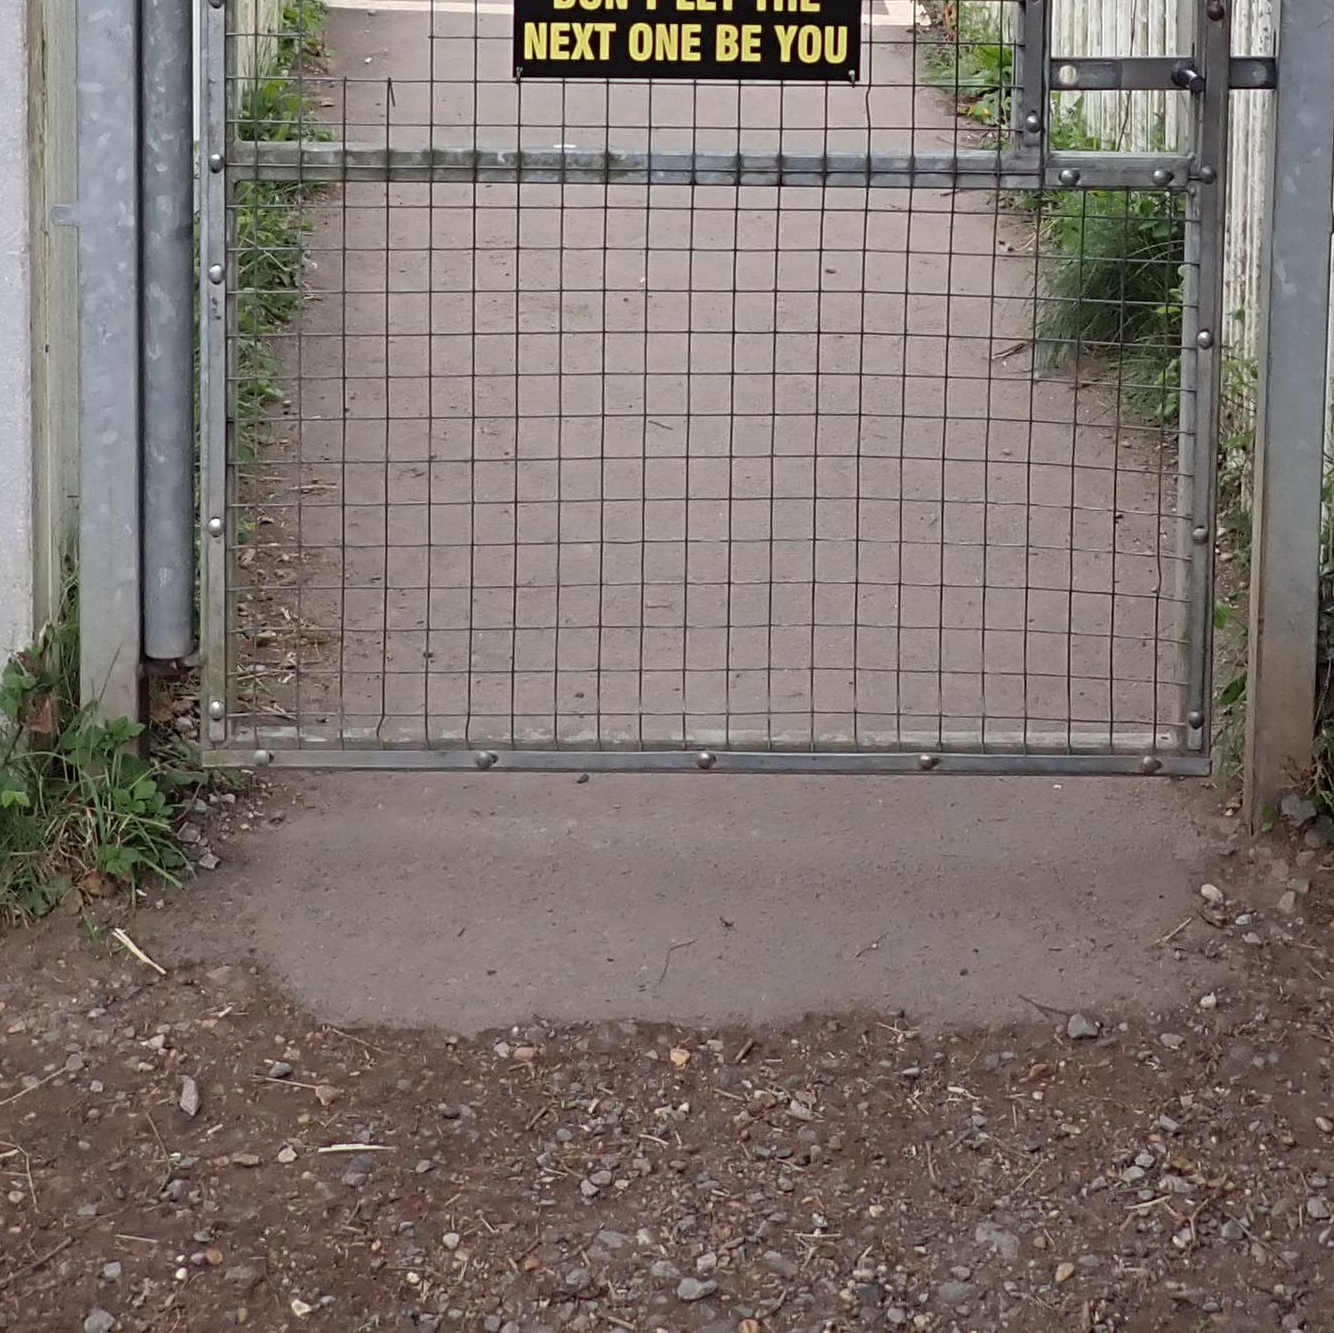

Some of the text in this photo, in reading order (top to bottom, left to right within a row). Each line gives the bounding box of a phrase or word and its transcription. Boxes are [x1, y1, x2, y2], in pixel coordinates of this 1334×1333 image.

[523, 21, 849, 64] NEXT ONE BE YOU
